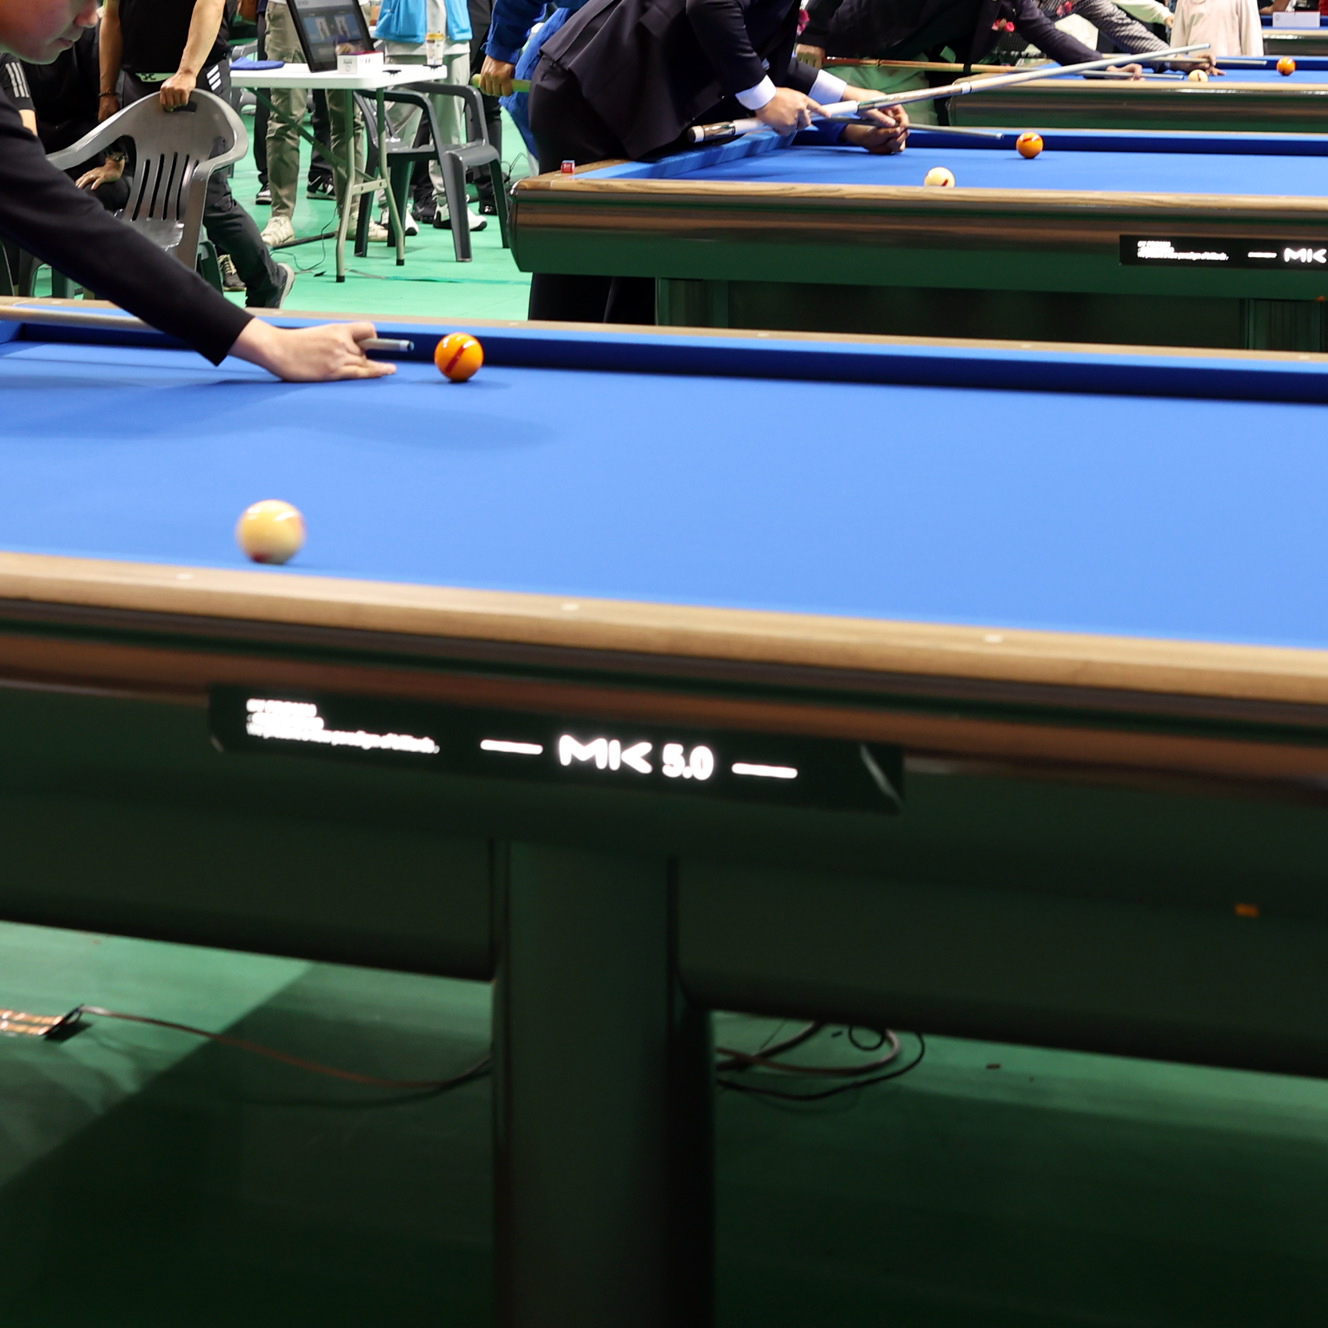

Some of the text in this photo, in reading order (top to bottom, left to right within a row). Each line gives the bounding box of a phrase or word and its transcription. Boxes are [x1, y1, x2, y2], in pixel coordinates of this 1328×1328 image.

[1283, 246, 1327, 264] MK
[559, 734, 715, 781] MK 5.0
